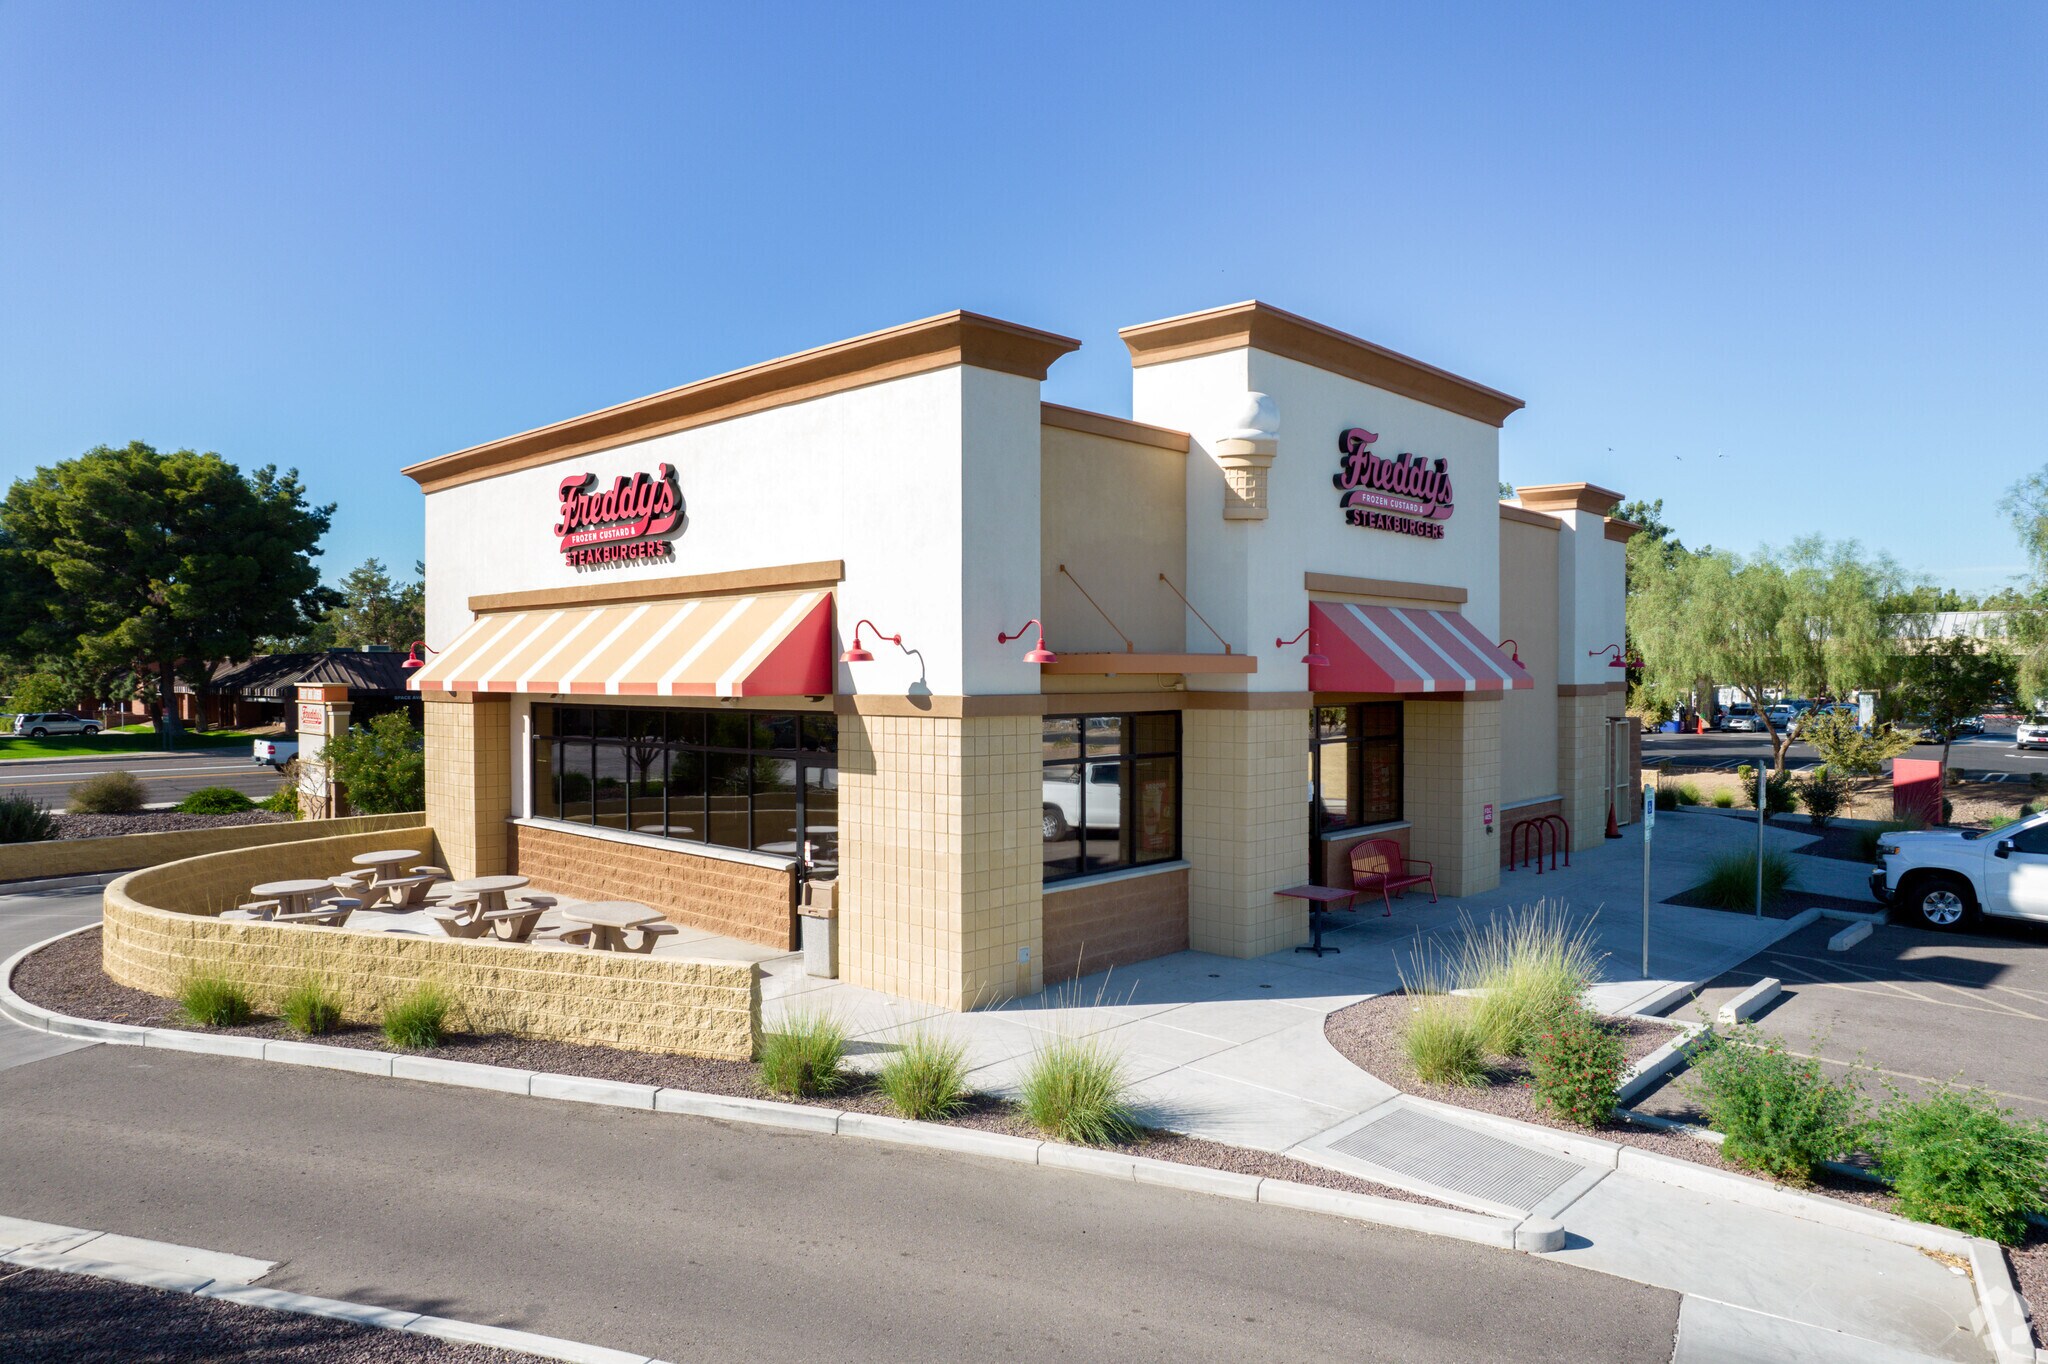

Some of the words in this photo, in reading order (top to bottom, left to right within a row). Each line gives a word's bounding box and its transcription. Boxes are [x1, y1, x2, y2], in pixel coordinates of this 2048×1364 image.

[1340, 427, 1453, 505] Freddy's
[553, 462, 675, 538] Freddy's
[1362, 493, 1388, 506] FROZEN
[1390, 499, 1418, 512] CUSTARD
[572, 532, 597, 544] FROZEN
[599, 527, 629, 540] CUSTARD
[630, 526, 636, 535] &
[1353, 508, 1445, 539] STEAKBURGERS
[565, 539, 665, 567] STEAKBURGERS
